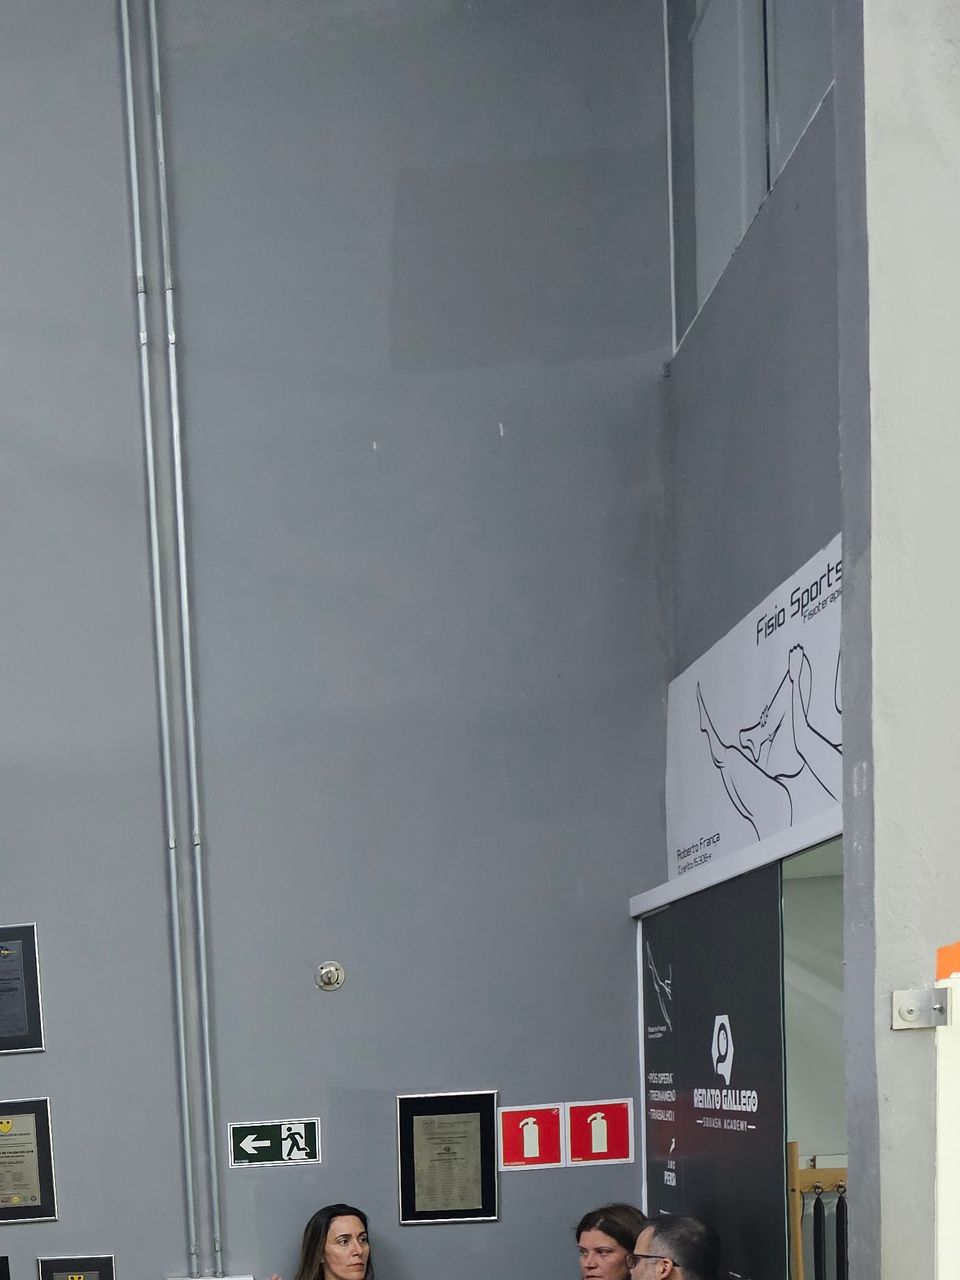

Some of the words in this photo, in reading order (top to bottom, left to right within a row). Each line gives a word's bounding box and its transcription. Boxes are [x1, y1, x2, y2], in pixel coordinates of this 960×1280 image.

[756, 604, 786, 646] Fisio
[790, 560, 842, 619] Sports
[676, 843, 699, 862] Roberto
[693, 1087, 721, 1110] RENATO
[721, 1088, 759, 1113] GALLEGO
[702, 1116, 722, 1129] SQUASH
[723, 1118, 748, 1132] ACADEMY
